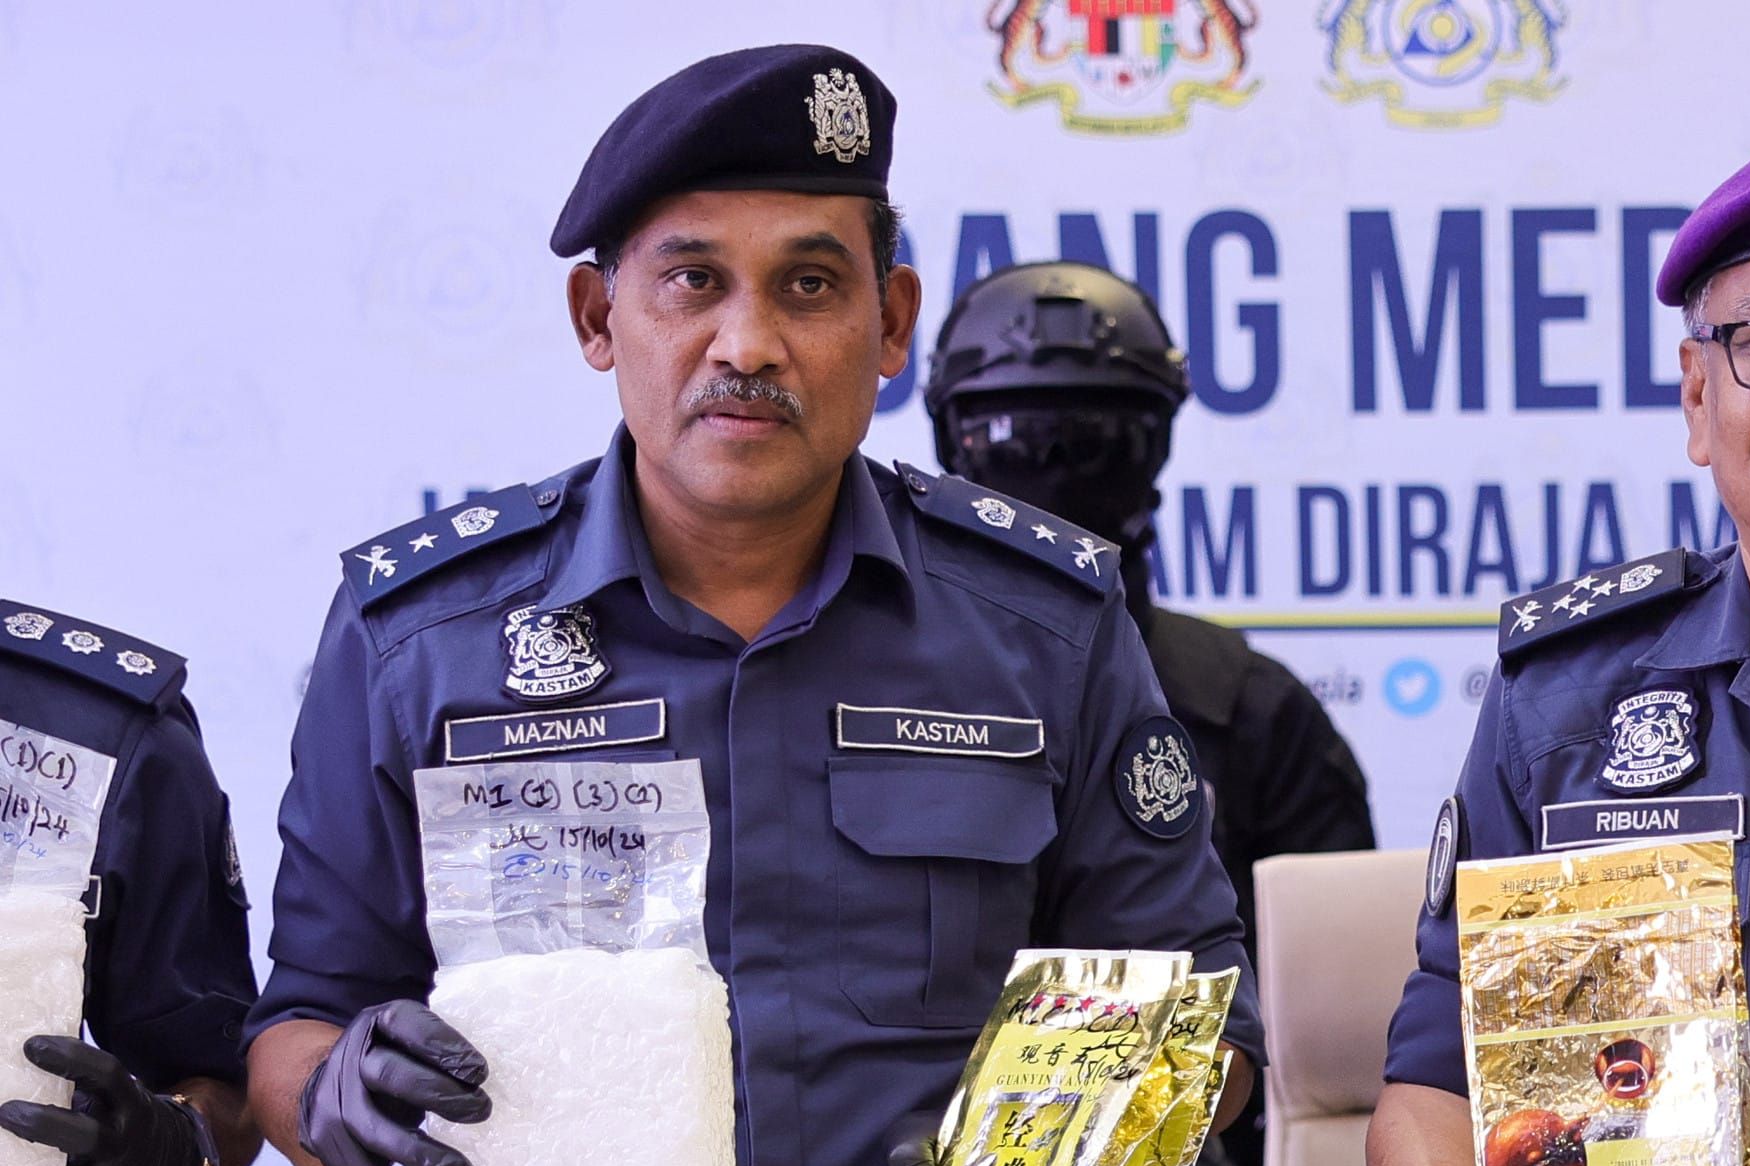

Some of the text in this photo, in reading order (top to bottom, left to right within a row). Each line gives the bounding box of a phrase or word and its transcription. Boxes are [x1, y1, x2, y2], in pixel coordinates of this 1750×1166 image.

[1296, 482, 1628, 597] DIRAJA
[523, 672, 592, 693] KASTAM
[1620, 690, 1687, 712] INTEGRITI
[503, 715, 607, 746] MAZNAN
[895, 718, 990, 746] KASTAM
[1615, 766, 1680, 785] KASTAM
[1595, 808, 1680, 833] RIBUAN
